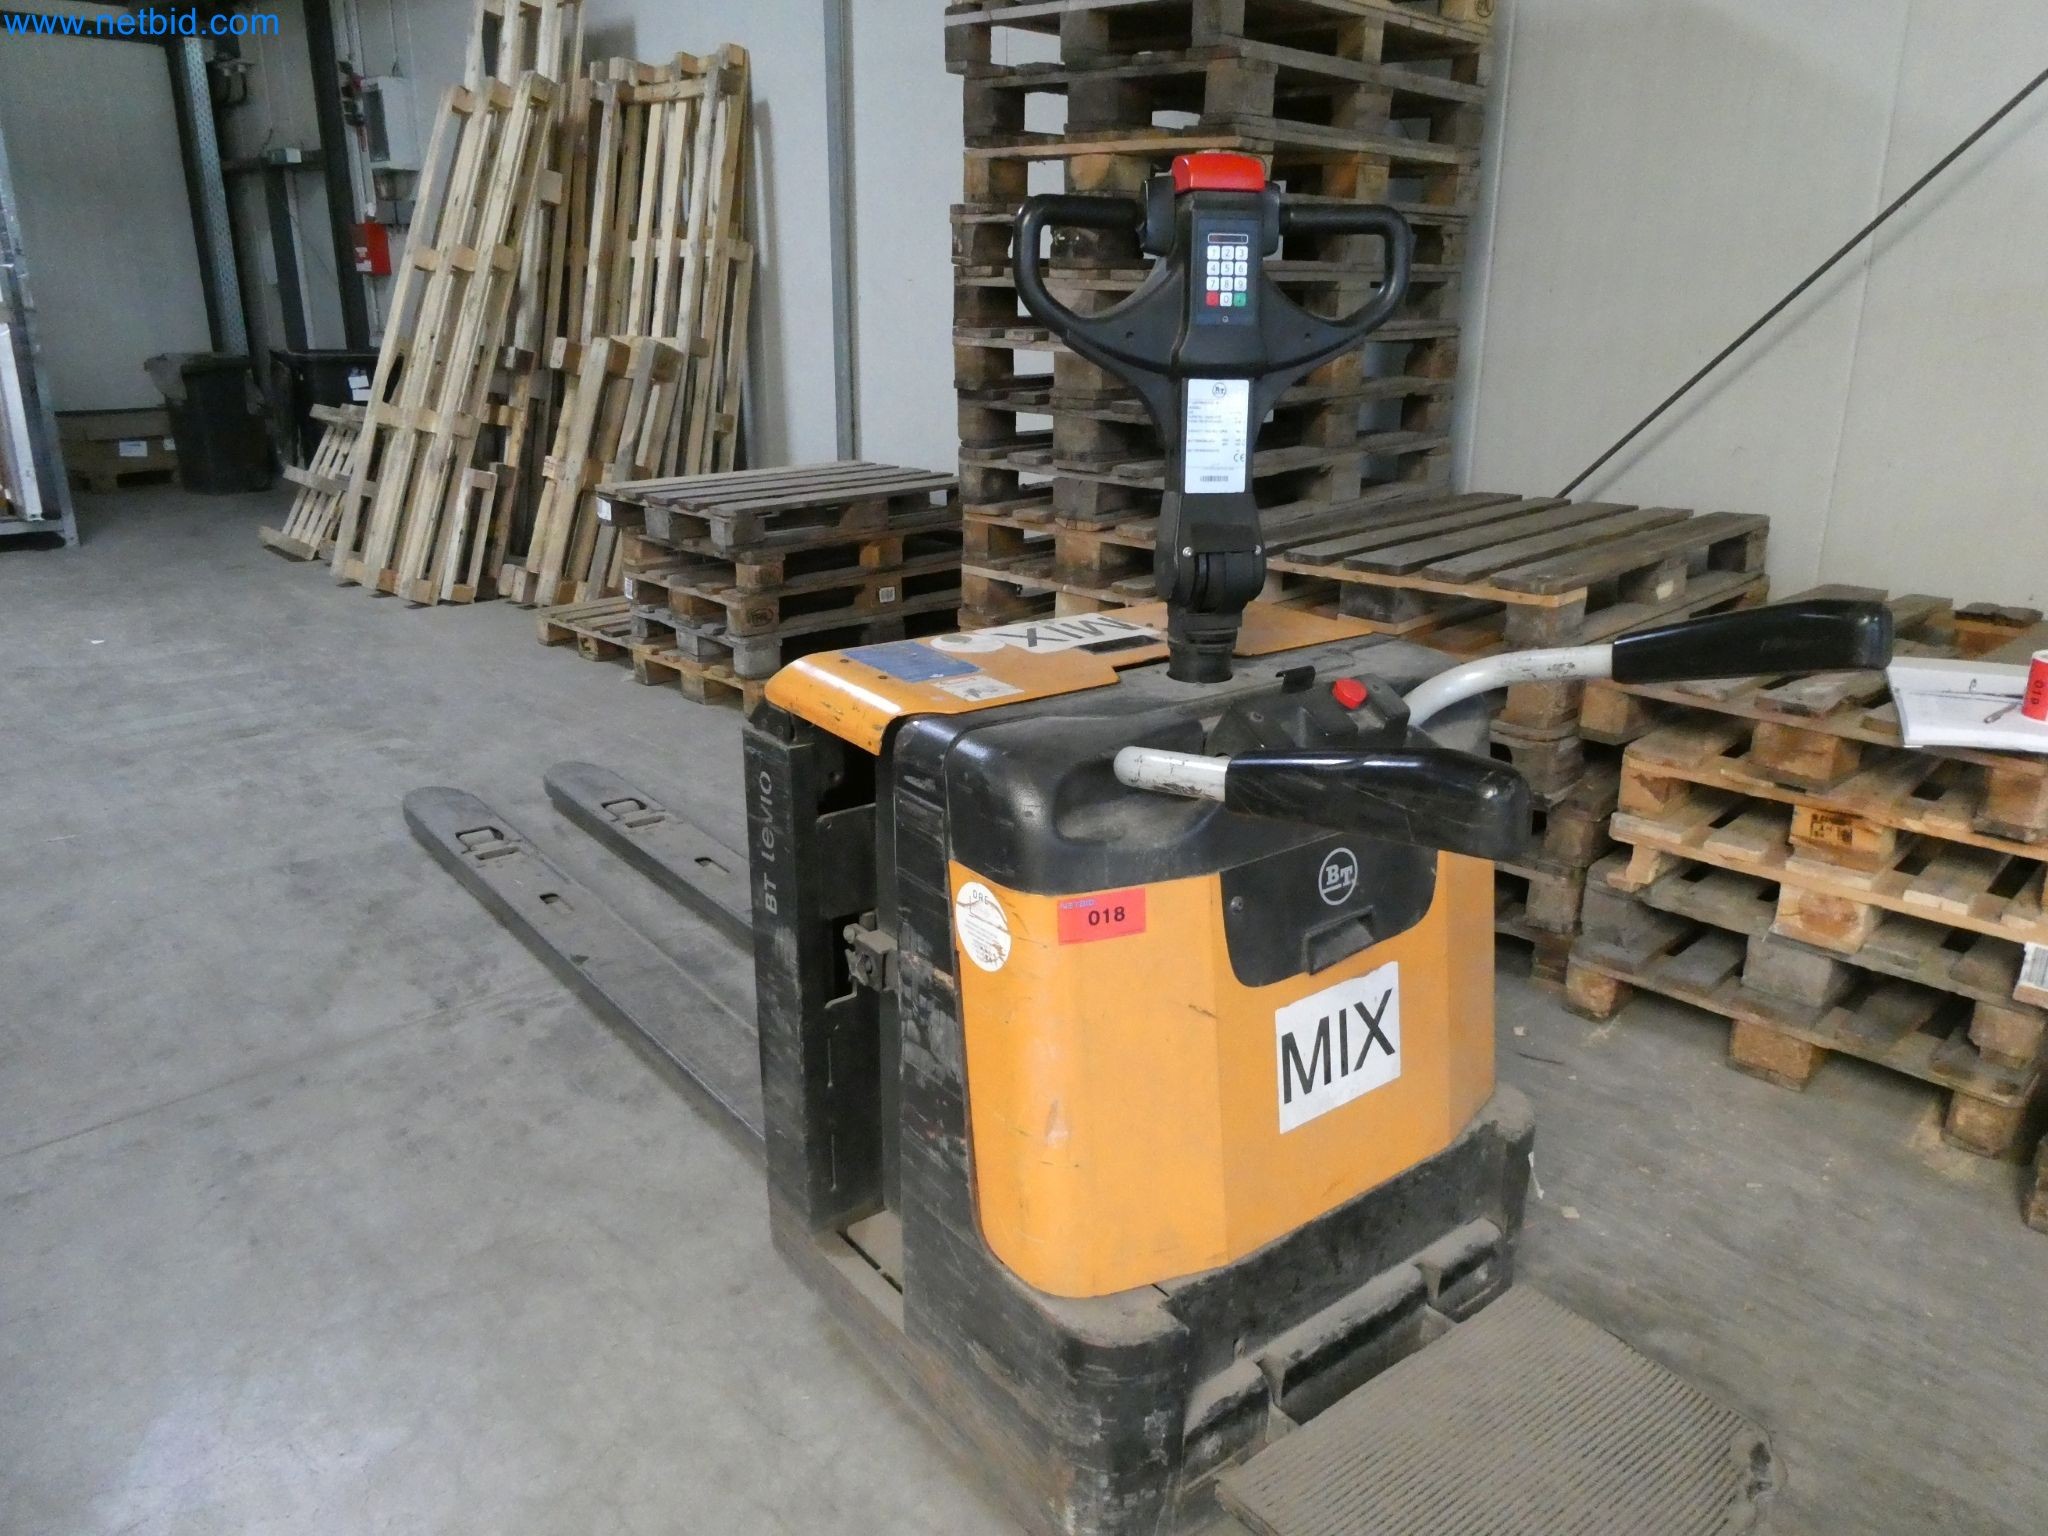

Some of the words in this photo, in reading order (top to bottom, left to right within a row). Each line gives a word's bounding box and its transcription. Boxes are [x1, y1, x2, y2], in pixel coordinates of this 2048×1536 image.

[992, 616, 1141, 648] MIX
[1325, 864, 1353, 887] BT
[763, 872, 778, 916] BT
[1087, 906, 1126, 926] 018
[1280, 987, 1396, 1105] MIX
